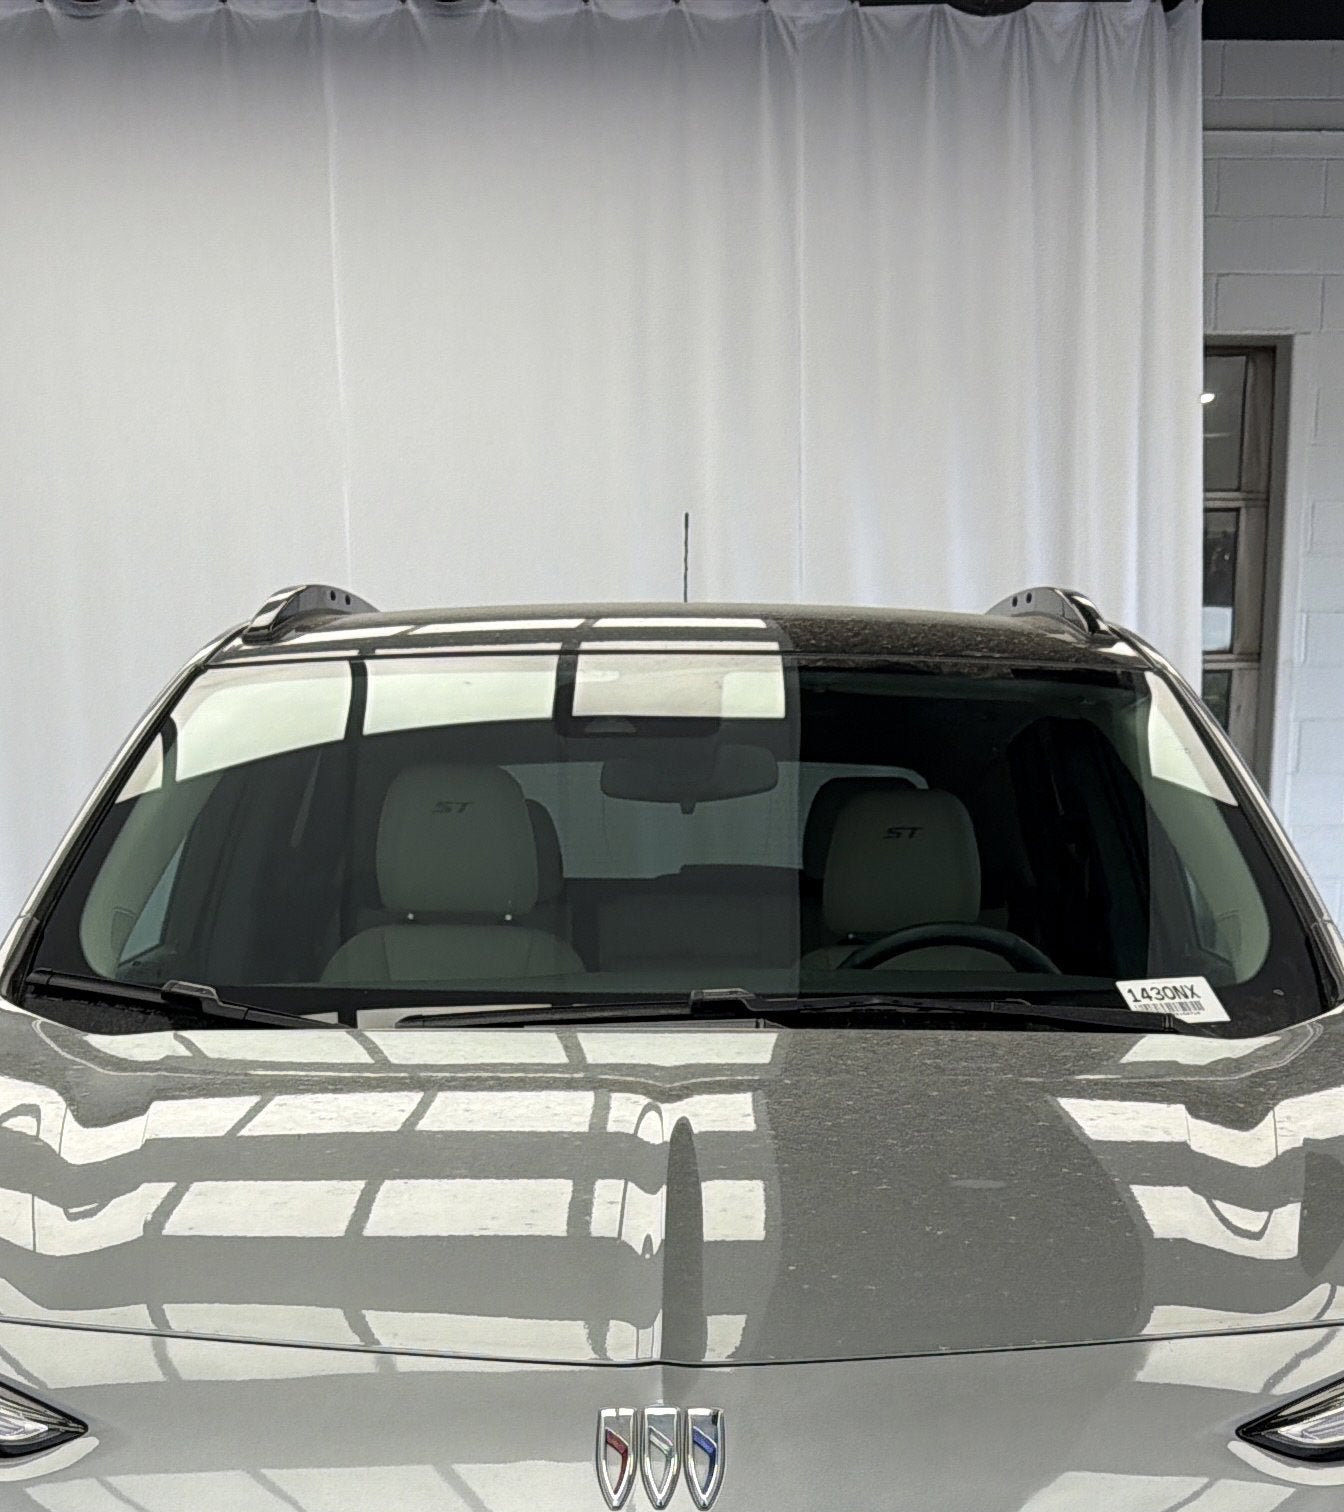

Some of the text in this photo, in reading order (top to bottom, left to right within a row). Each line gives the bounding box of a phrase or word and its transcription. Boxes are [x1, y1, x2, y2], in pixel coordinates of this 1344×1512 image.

[432, 801, 475, 813] ST
[883, 826, 924, 839] ST
[1127, 984, 1201, 1002] 1430NX
